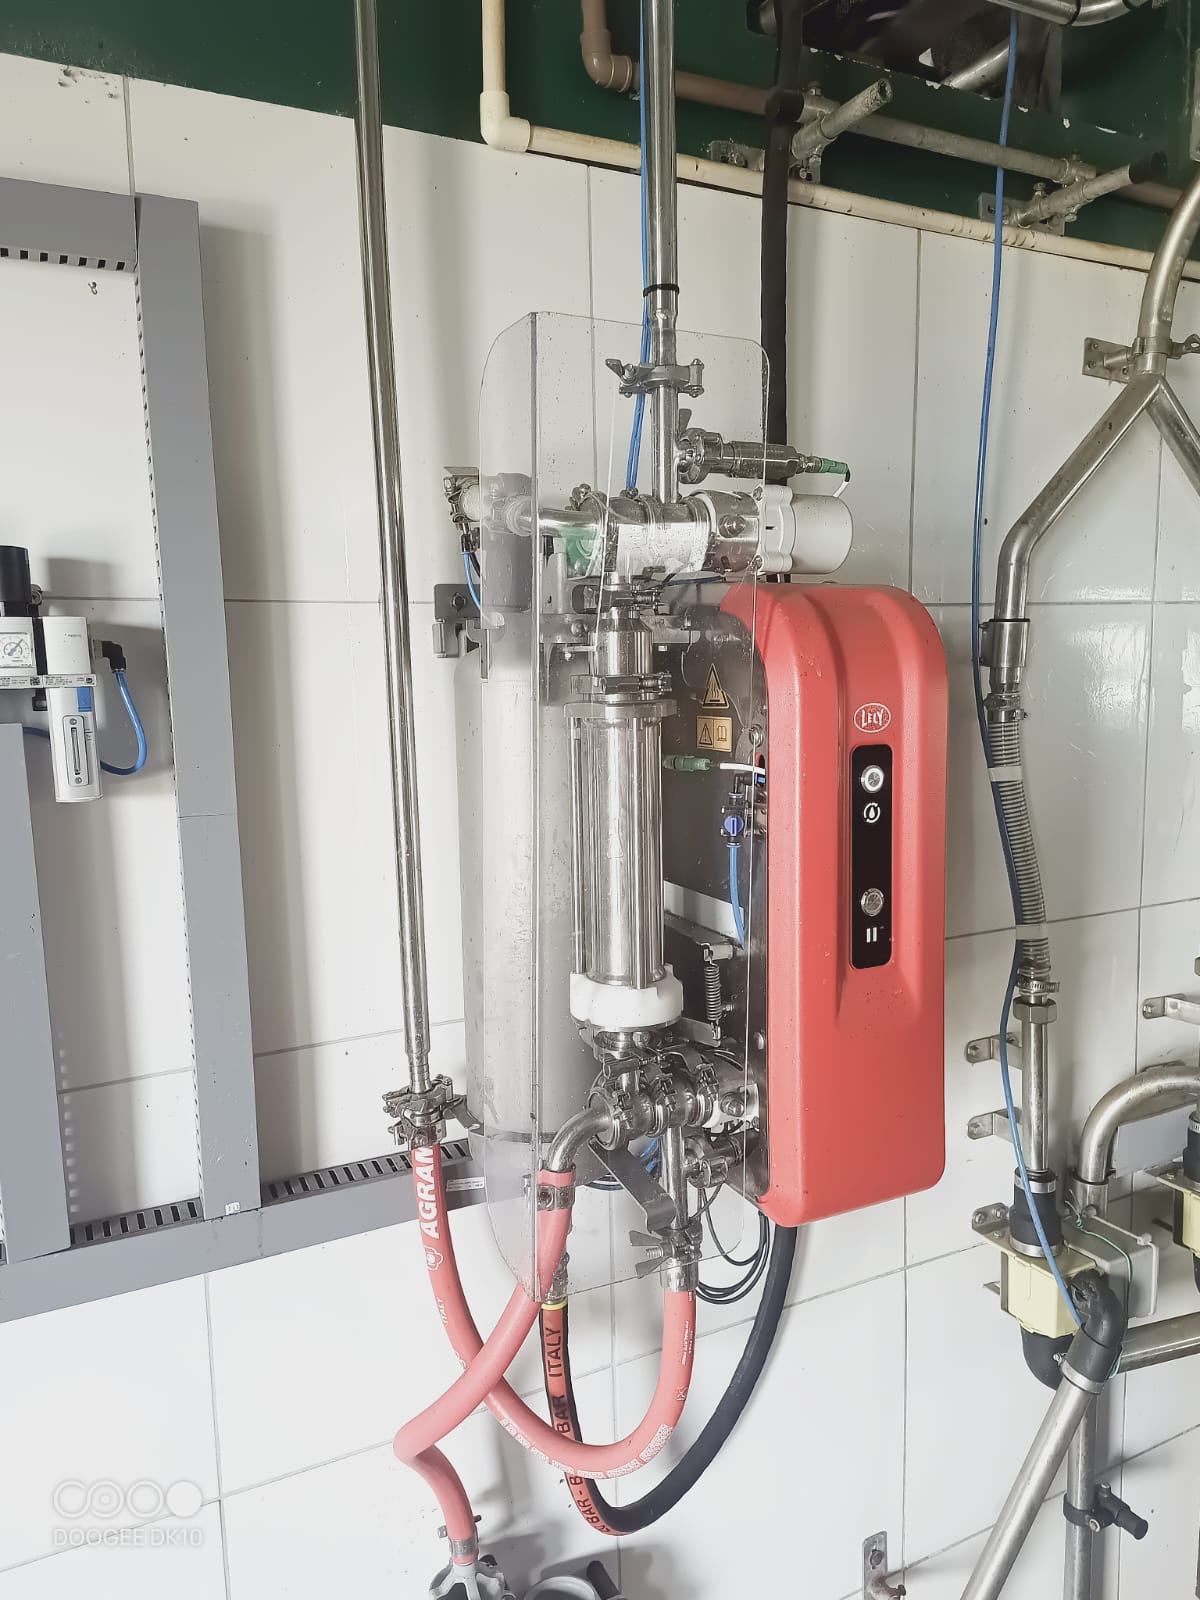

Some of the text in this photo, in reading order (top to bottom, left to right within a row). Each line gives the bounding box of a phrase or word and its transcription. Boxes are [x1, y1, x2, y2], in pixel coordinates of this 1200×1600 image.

[861, 708, 884, 728] LELY
[545, 1326, 563, 1378] ITALY
[552, 1394, 571, 1434] BAR
[577, 1498, 600, 1524] BAR
